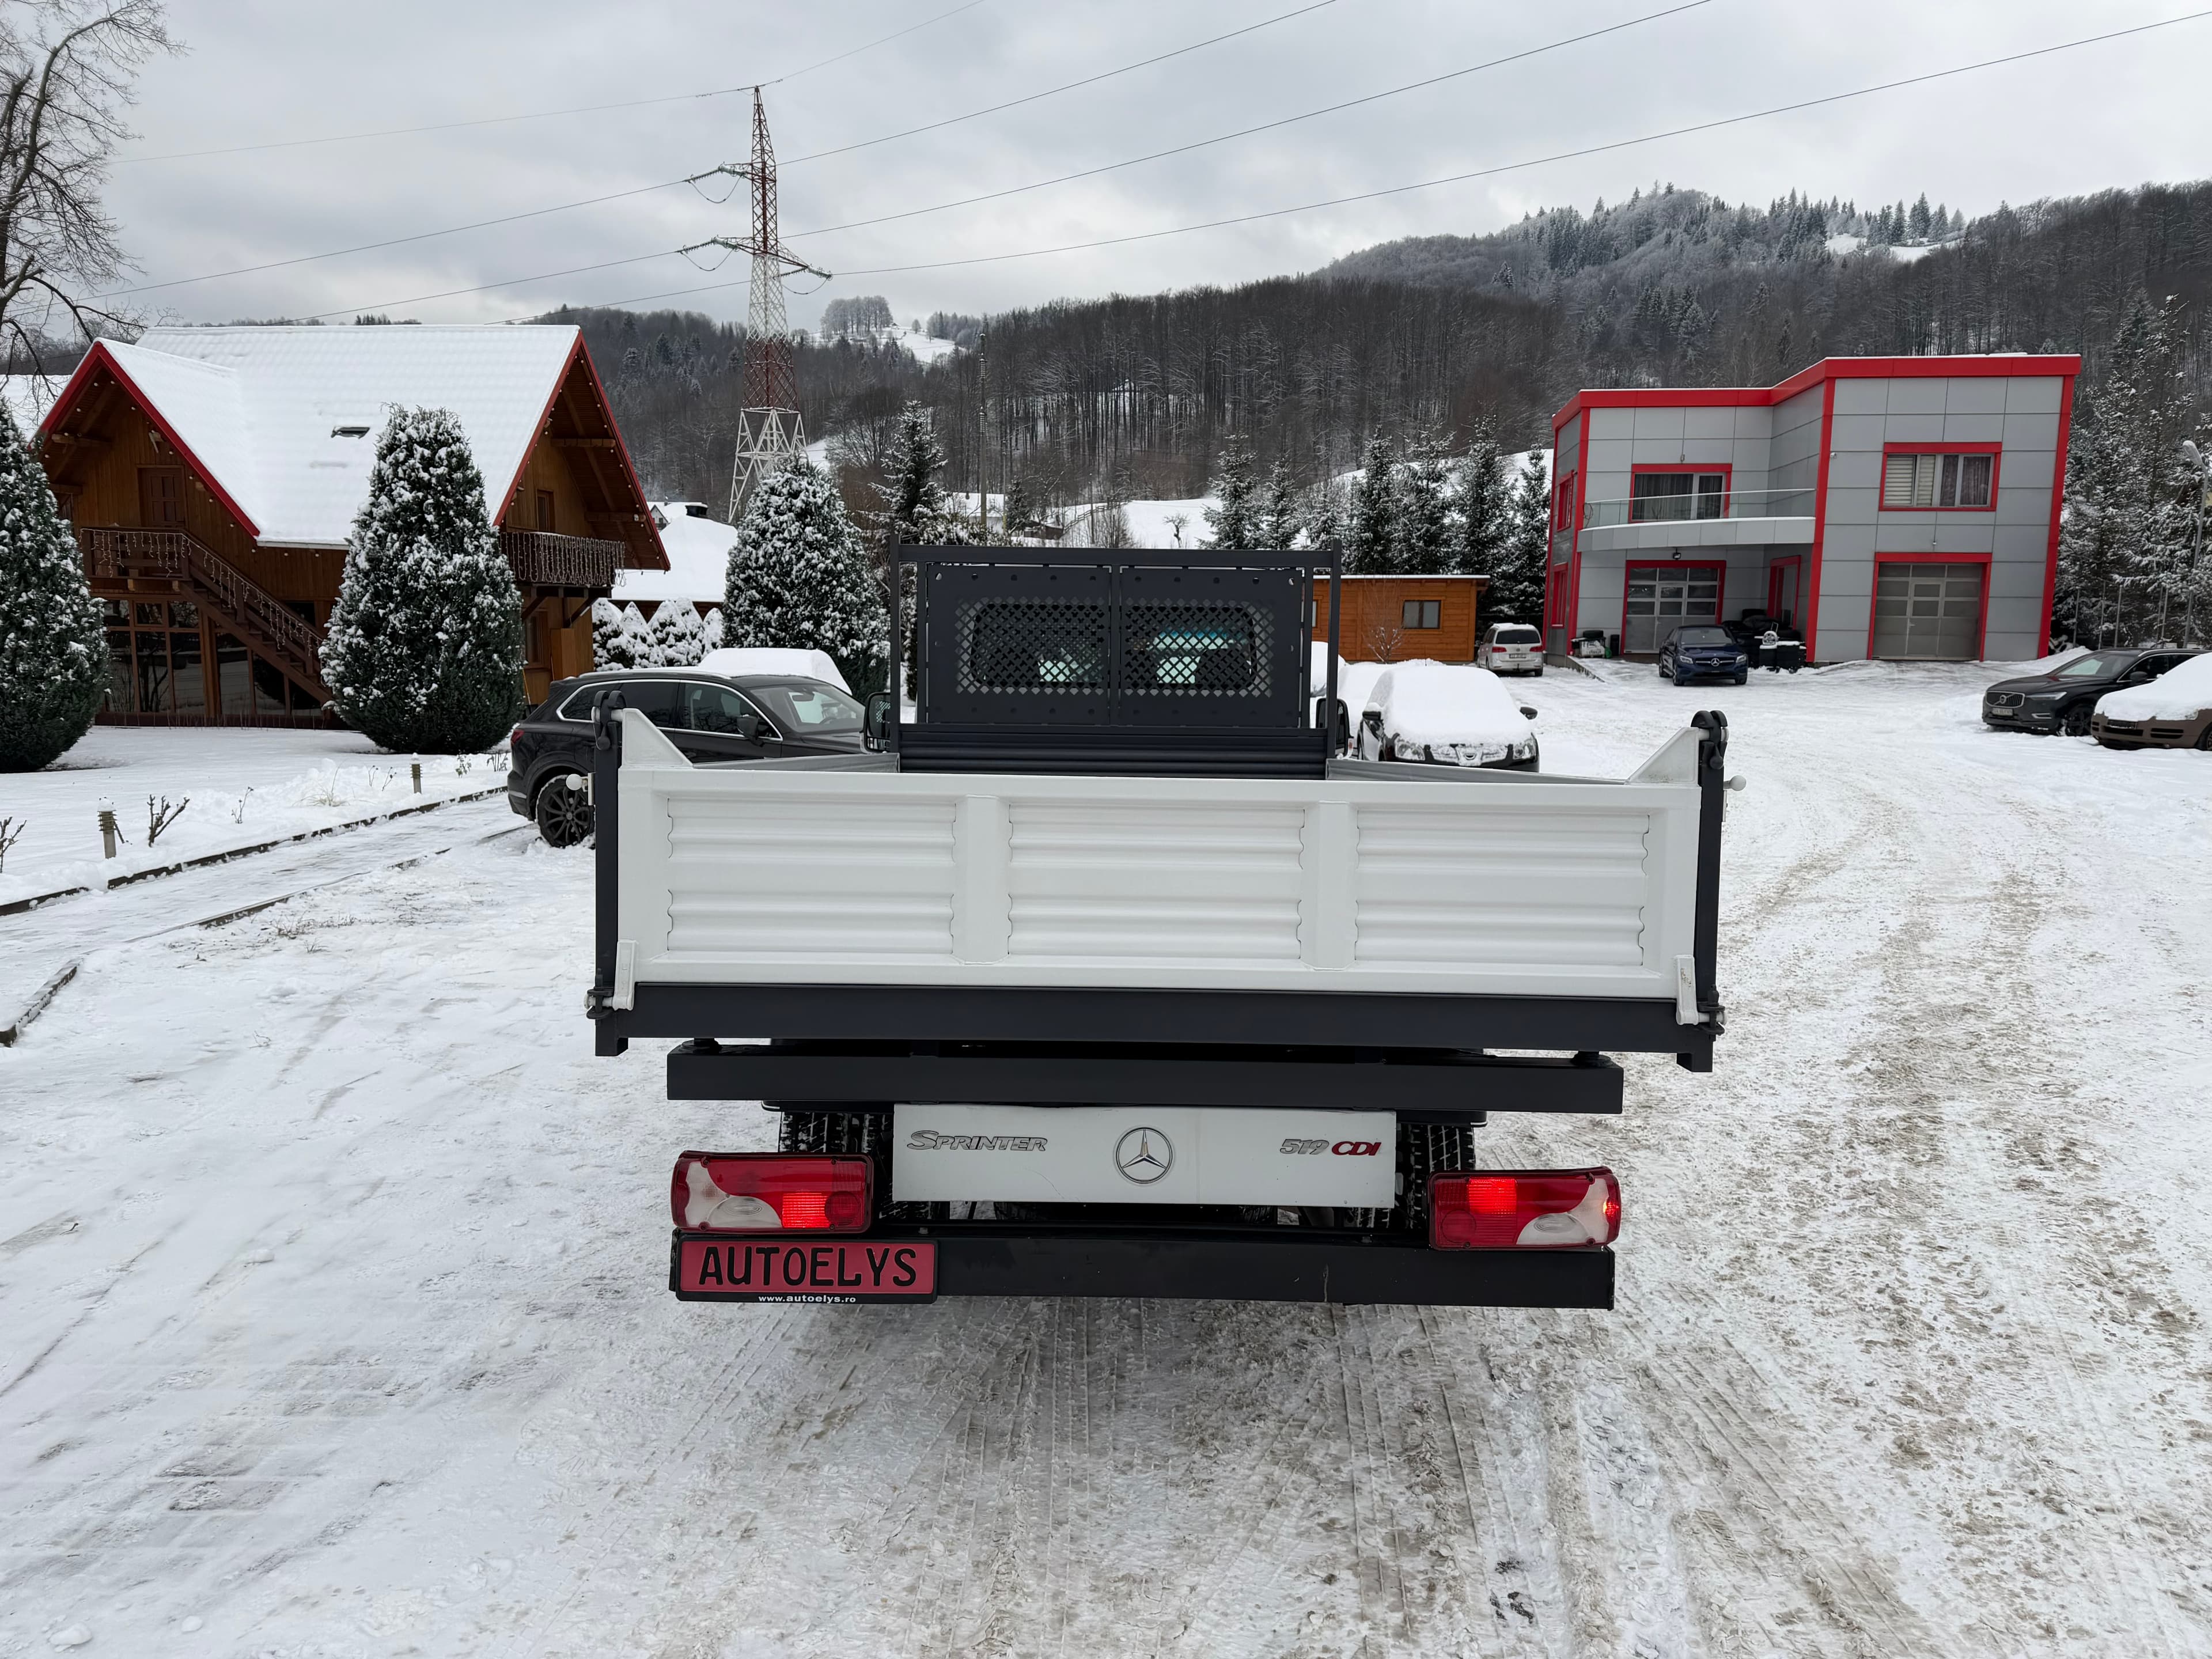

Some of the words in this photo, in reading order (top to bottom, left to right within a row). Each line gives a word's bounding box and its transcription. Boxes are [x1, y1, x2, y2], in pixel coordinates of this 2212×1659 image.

[907, 1130, 1048, 1152] SPRINTER
[1279, 1138, 1330, 1155] 519
[1331, 1141, 1382, 1156] CDI
[698, 1246, 917, 1287] AUTOELYS
[757, 1294, 857, 1304] www.autoelys.ro
